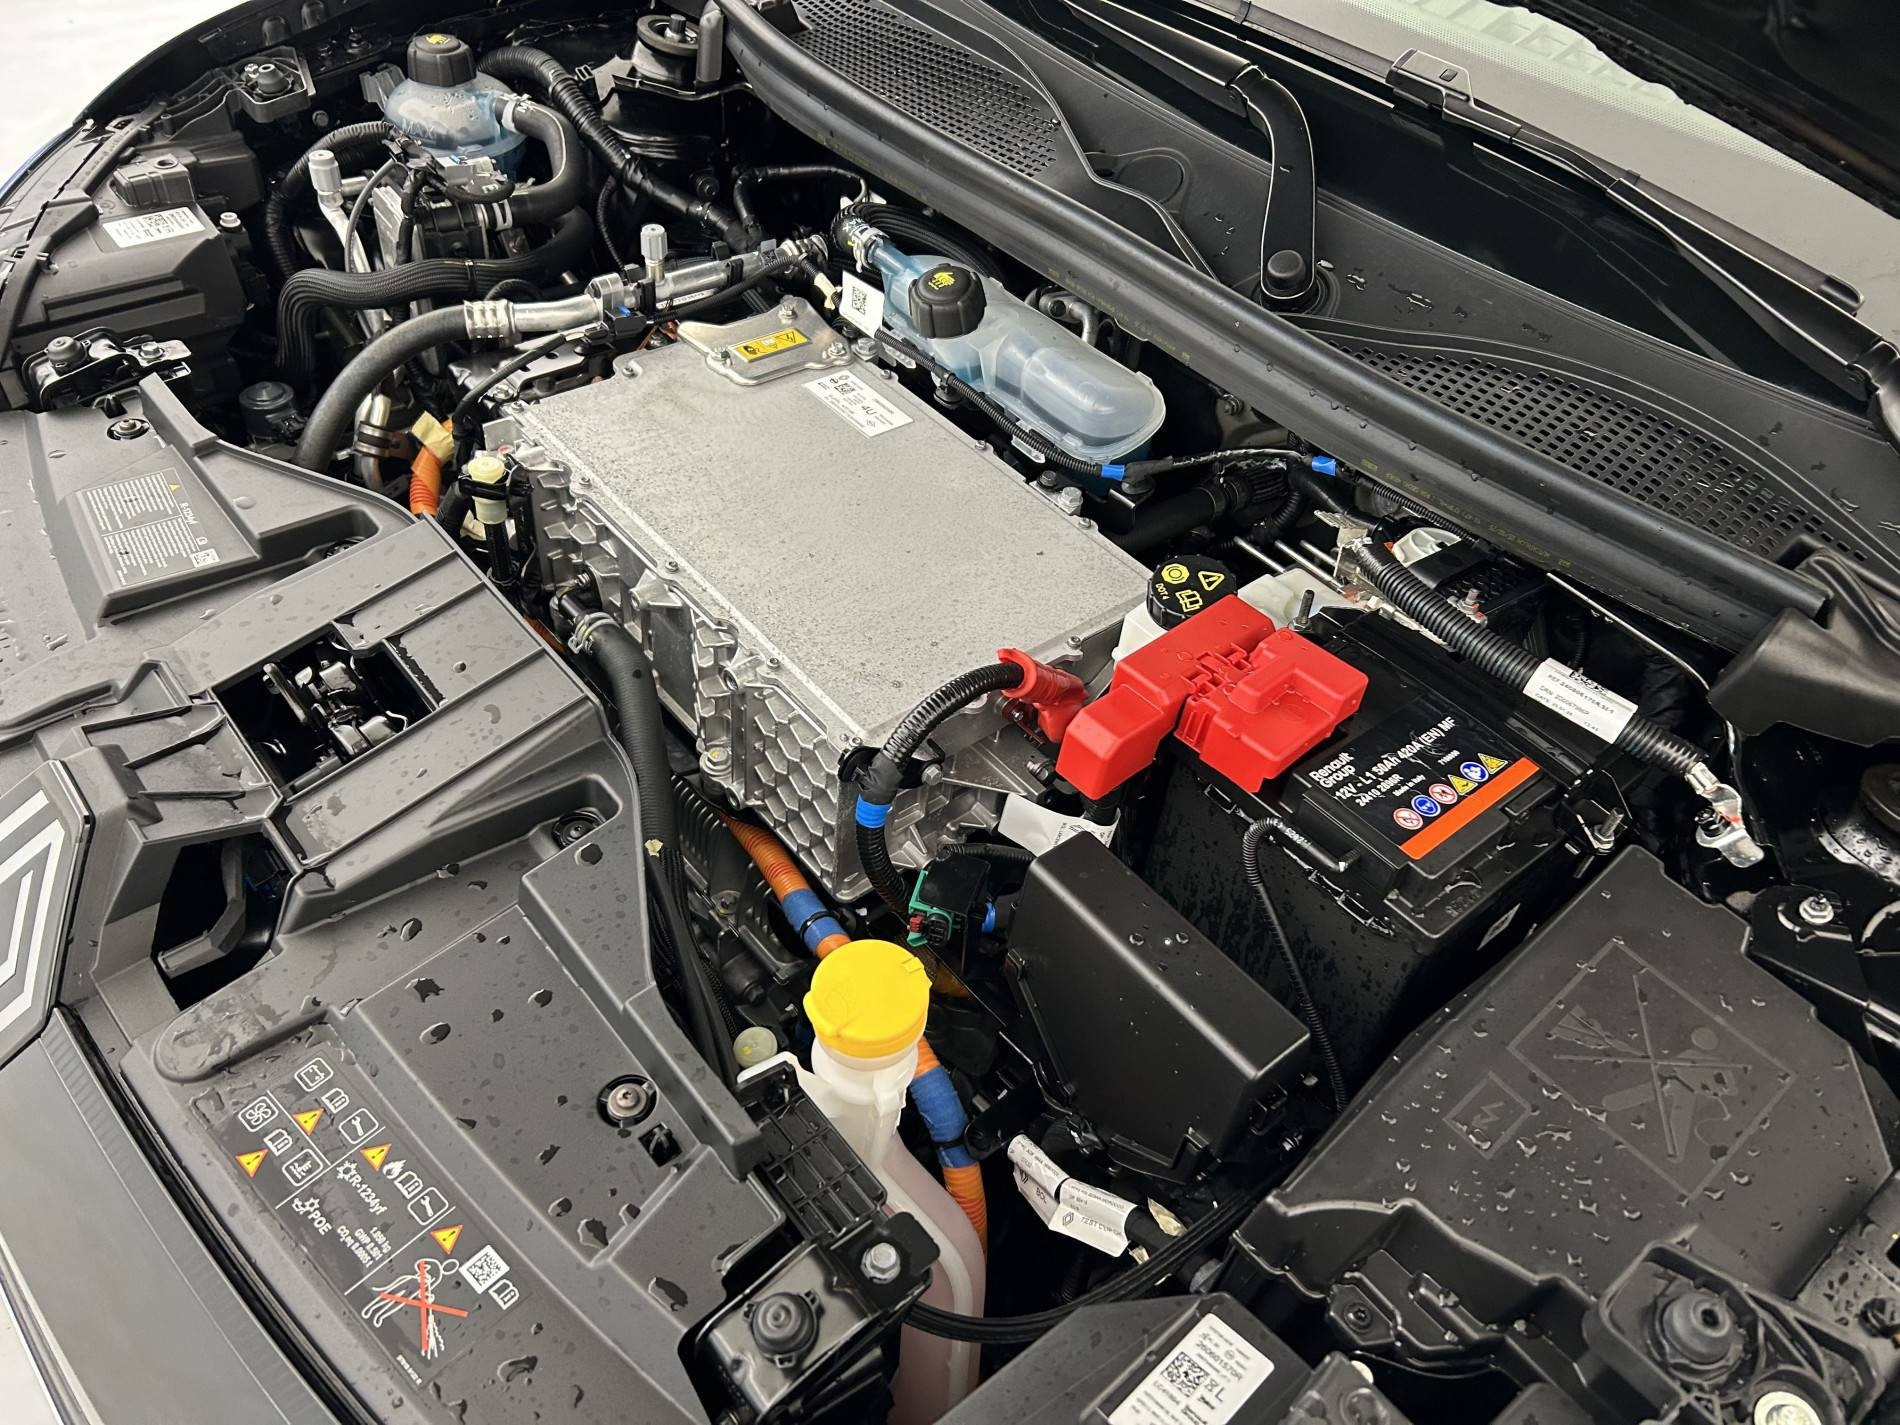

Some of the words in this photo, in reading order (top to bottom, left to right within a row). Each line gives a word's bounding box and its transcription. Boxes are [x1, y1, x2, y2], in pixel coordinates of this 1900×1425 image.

[1309, 752, 1354, 782] Renault
[1335, 783, 1357, 800] 12V
[1359, 772, 1377, 785] L1
[1371, 755, 1402, 776] 50Ah
[1396, 740, 1425, 759] 420A
[1418, 727, 1446, 746] (EN)
[1437, 716, 1456, 732] MF
[1320, 765, 1356, 788] Group
[349, 1174, 388, 1215] R-1234yf
[307, 1210, 333, 1235] POE
[354, 1228, 371, 1244] GWP
[381, 1241, 392, 1254] kg
